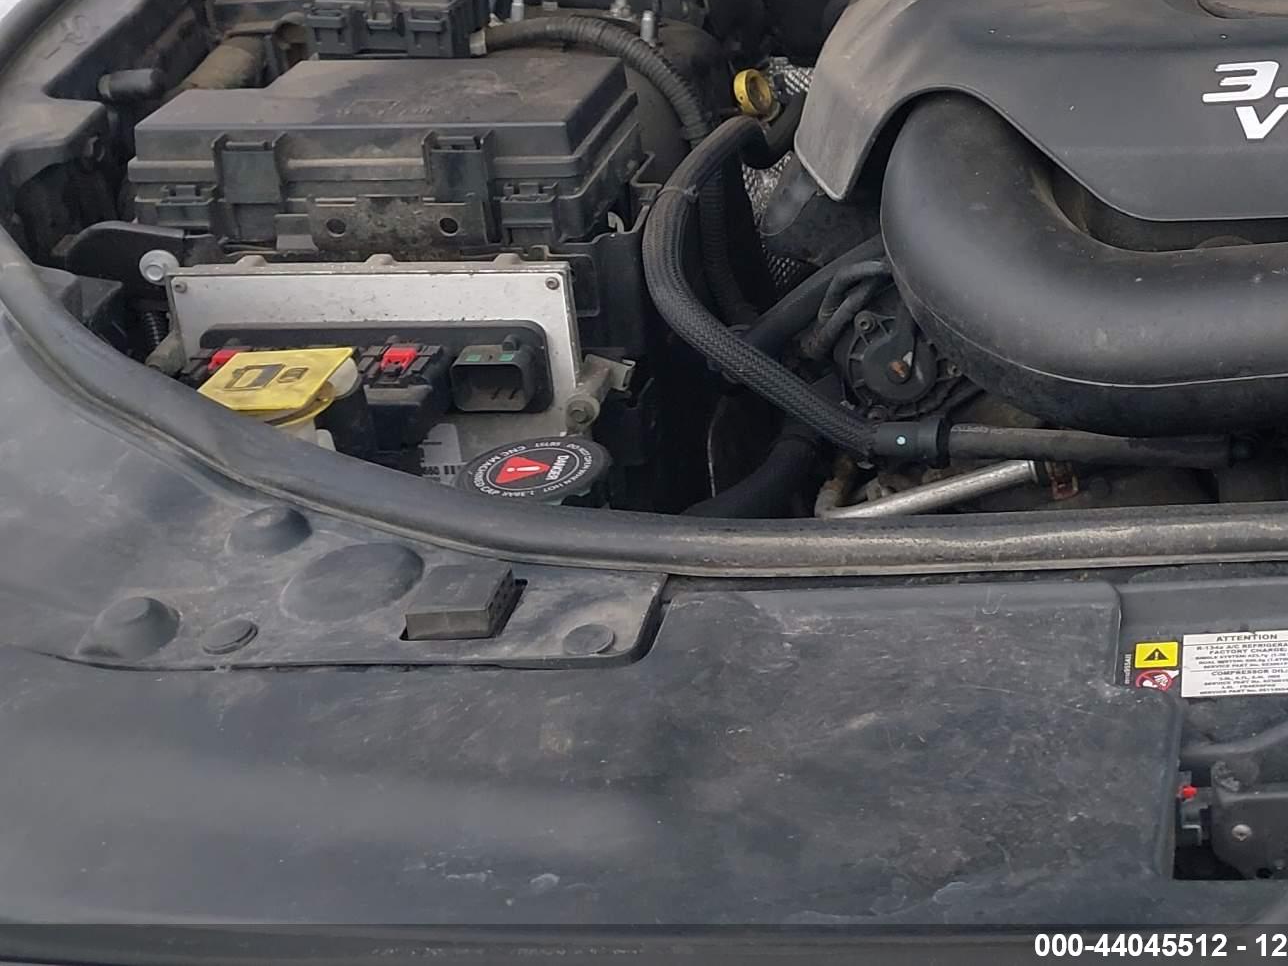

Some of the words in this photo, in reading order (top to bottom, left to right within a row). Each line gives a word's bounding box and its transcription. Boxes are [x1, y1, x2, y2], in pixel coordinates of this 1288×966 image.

[502, 445, 527, 457] CNC
[545, 454, 570, 481] DANGER
[480, 486, 501, 495] CAP
[1216, 634, 1278, 642] ATTENTION
